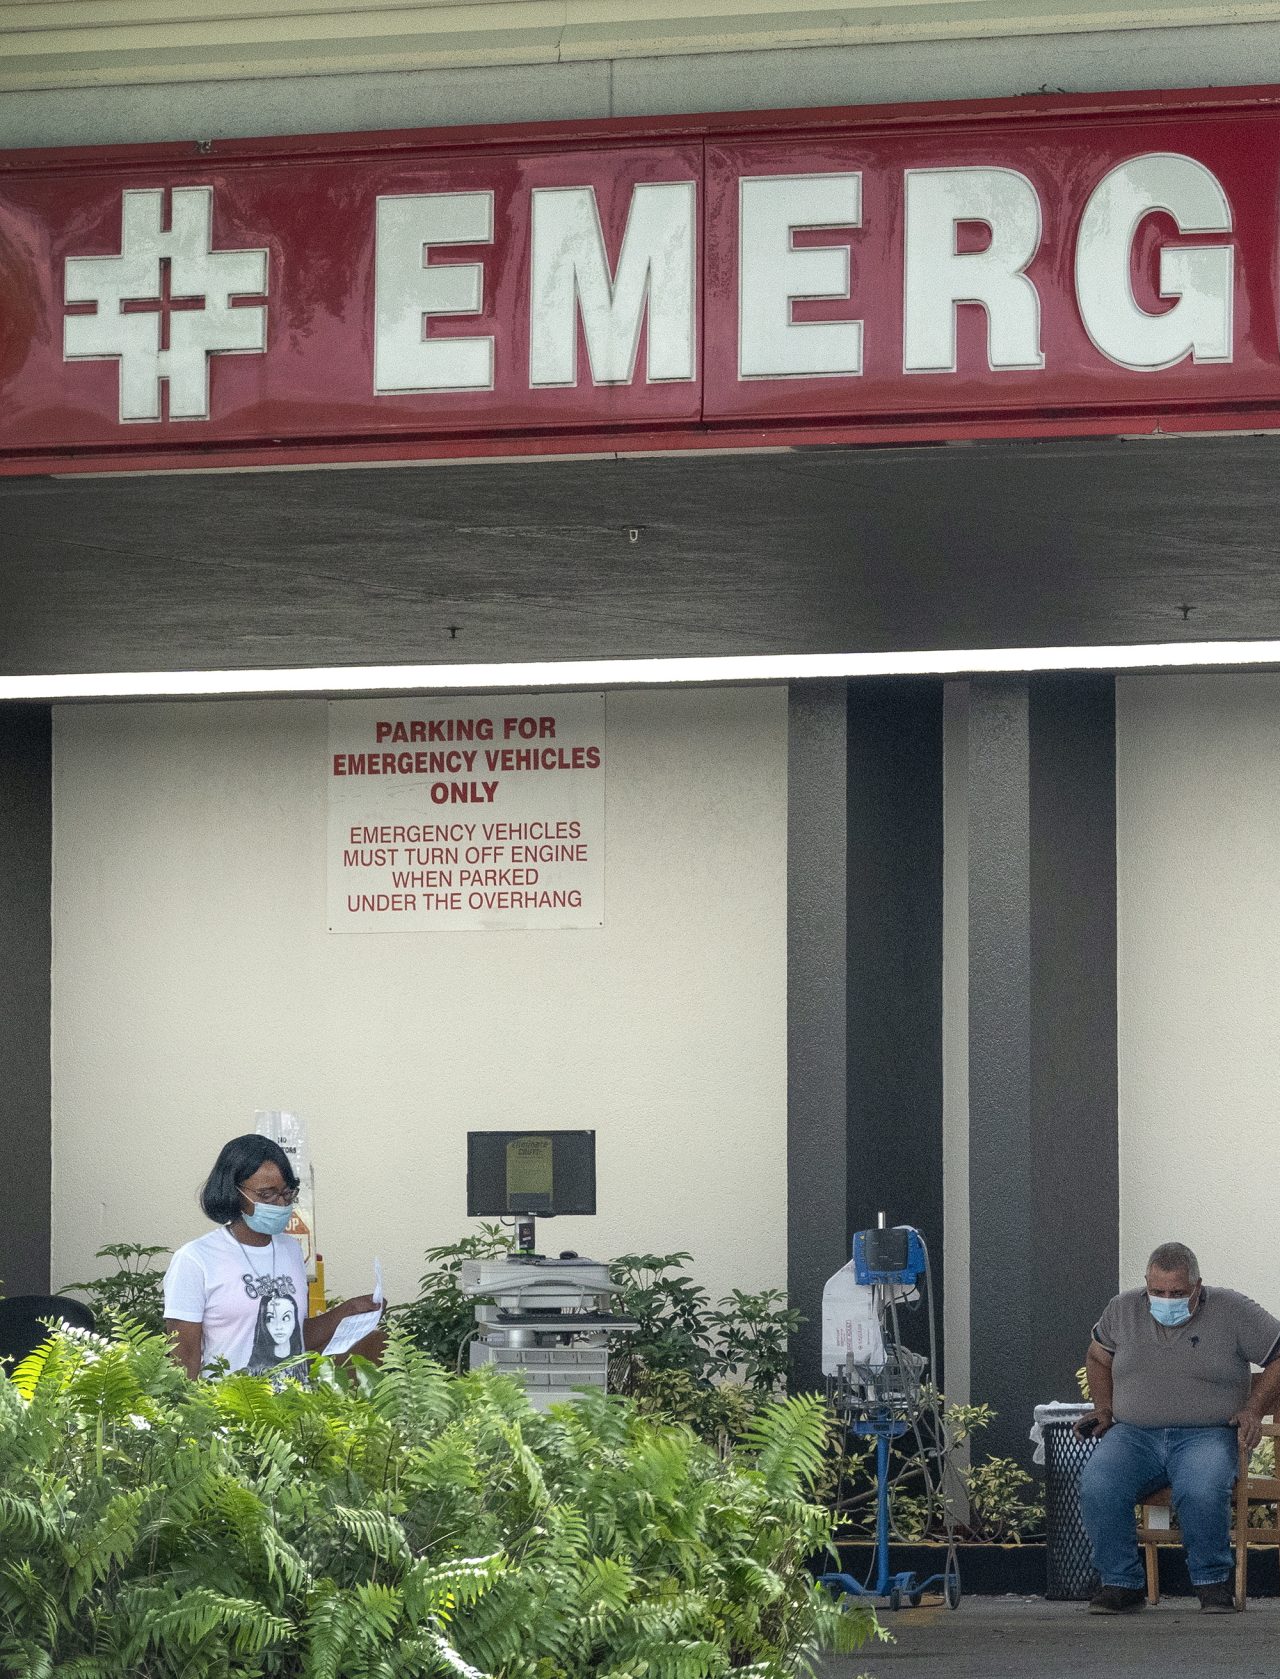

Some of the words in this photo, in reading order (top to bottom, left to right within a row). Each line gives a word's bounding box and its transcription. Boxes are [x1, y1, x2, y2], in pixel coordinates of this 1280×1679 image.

[375, 719, 494, 743] PARKING
[503, 716, 556, 740] FOR
[333, 750, 477, 776] EMERGENCY
[485, 746, 601, 771] VEHICLES
[429, 780, 499, 805] ONLY
[350, 824, 476, 844] EMERGENCY
[481, 821, 582, 841] VEHICLES
[343, 848, 399, 867] MUST
[404, 847, 458, 866] TURN
[465, 846, 505, 864] OFF
[511, 844, 588, 862] ENGINE
[391, 870, 453, 888] WHEN
[459, 868, 539, 886] PARKED
[347, 894, 417, 912] UNDER
[422, 893, 462, 911] THE
[468, 890, 582, 909] OVERHANG
